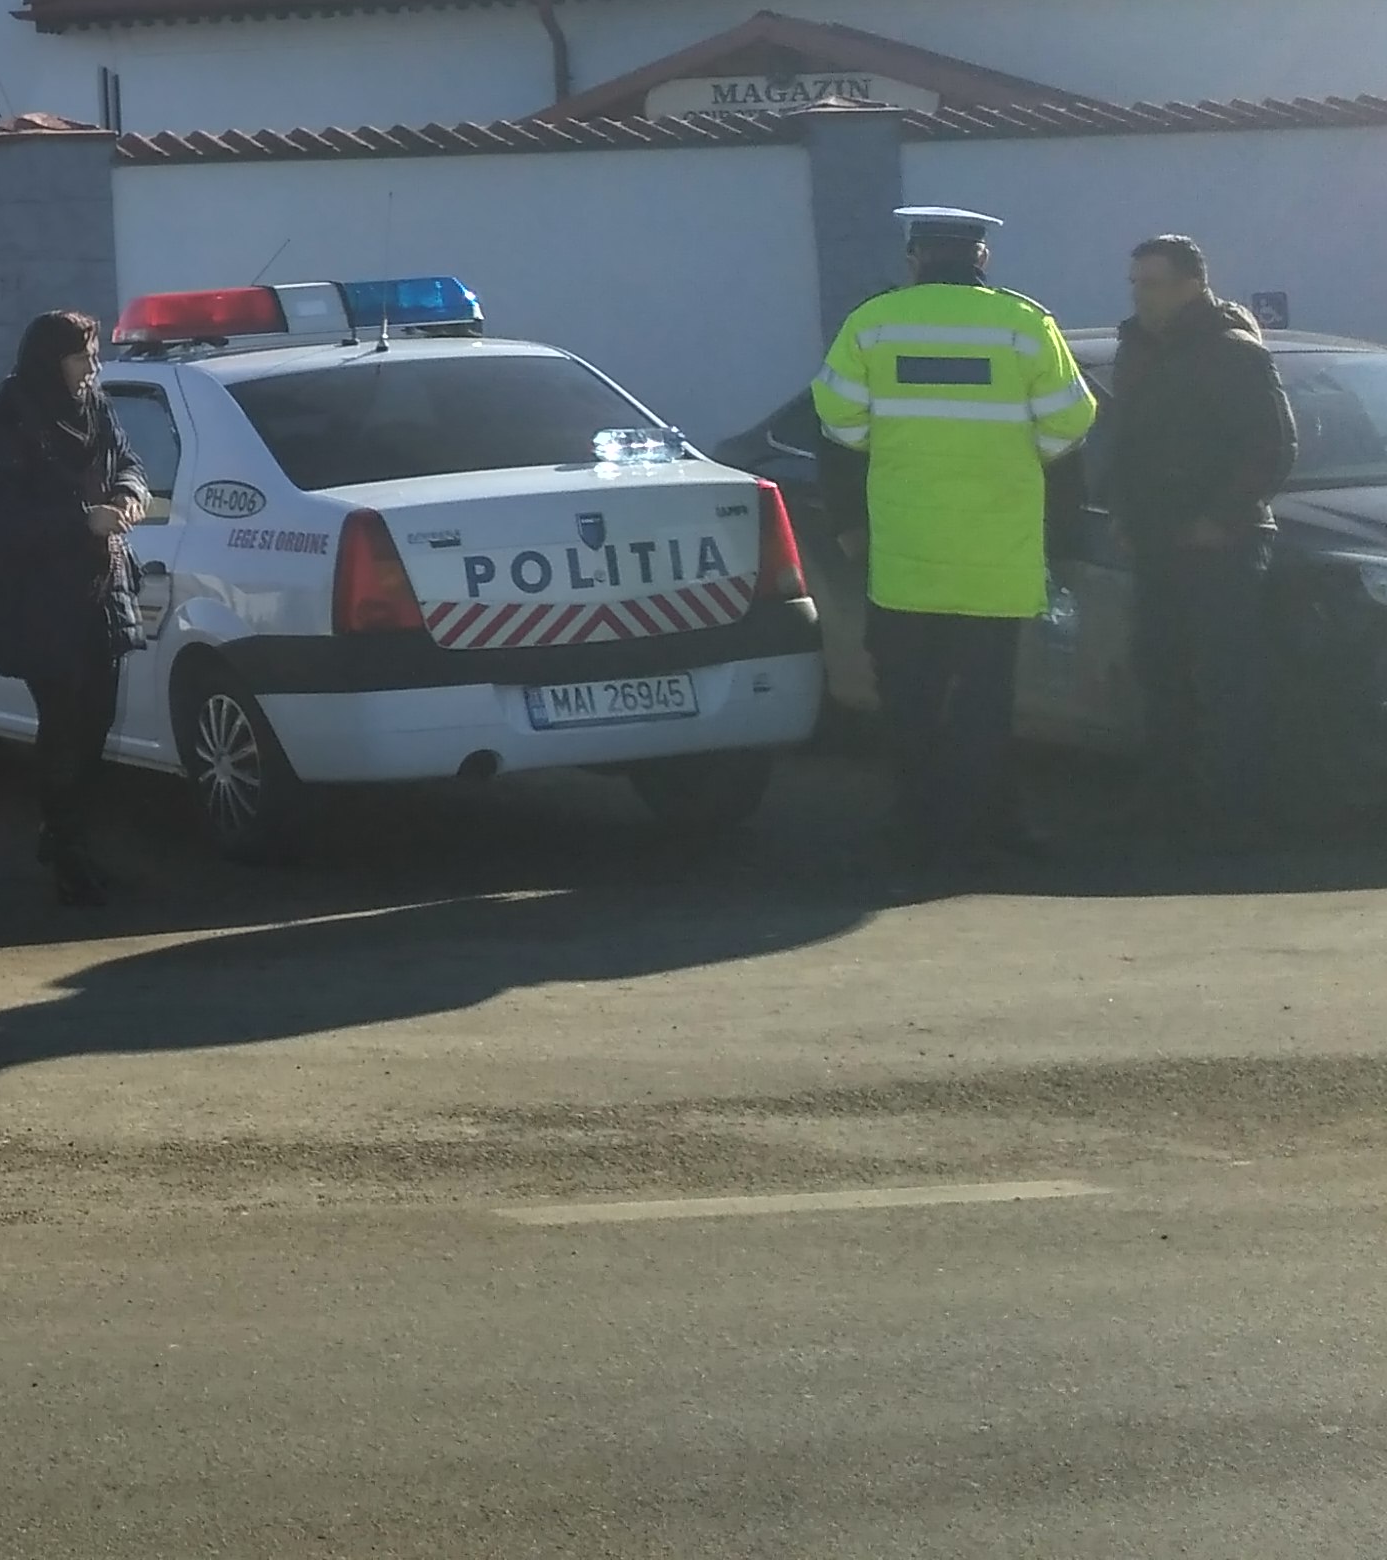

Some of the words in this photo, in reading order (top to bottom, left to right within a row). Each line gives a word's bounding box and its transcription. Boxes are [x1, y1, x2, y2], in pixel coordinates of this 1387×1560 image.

[711, 79, 872, 105] MAGAZIN
[203, 487, 257, 513] PH-006
[227, 528, 255, 549] LEGE
[276, 530, 330, 555] ORDINE
[463, 536, 729, 598] POLITIA
[550, 685, 596, 718] MAI
[604, 678, 686, 713] 26945
